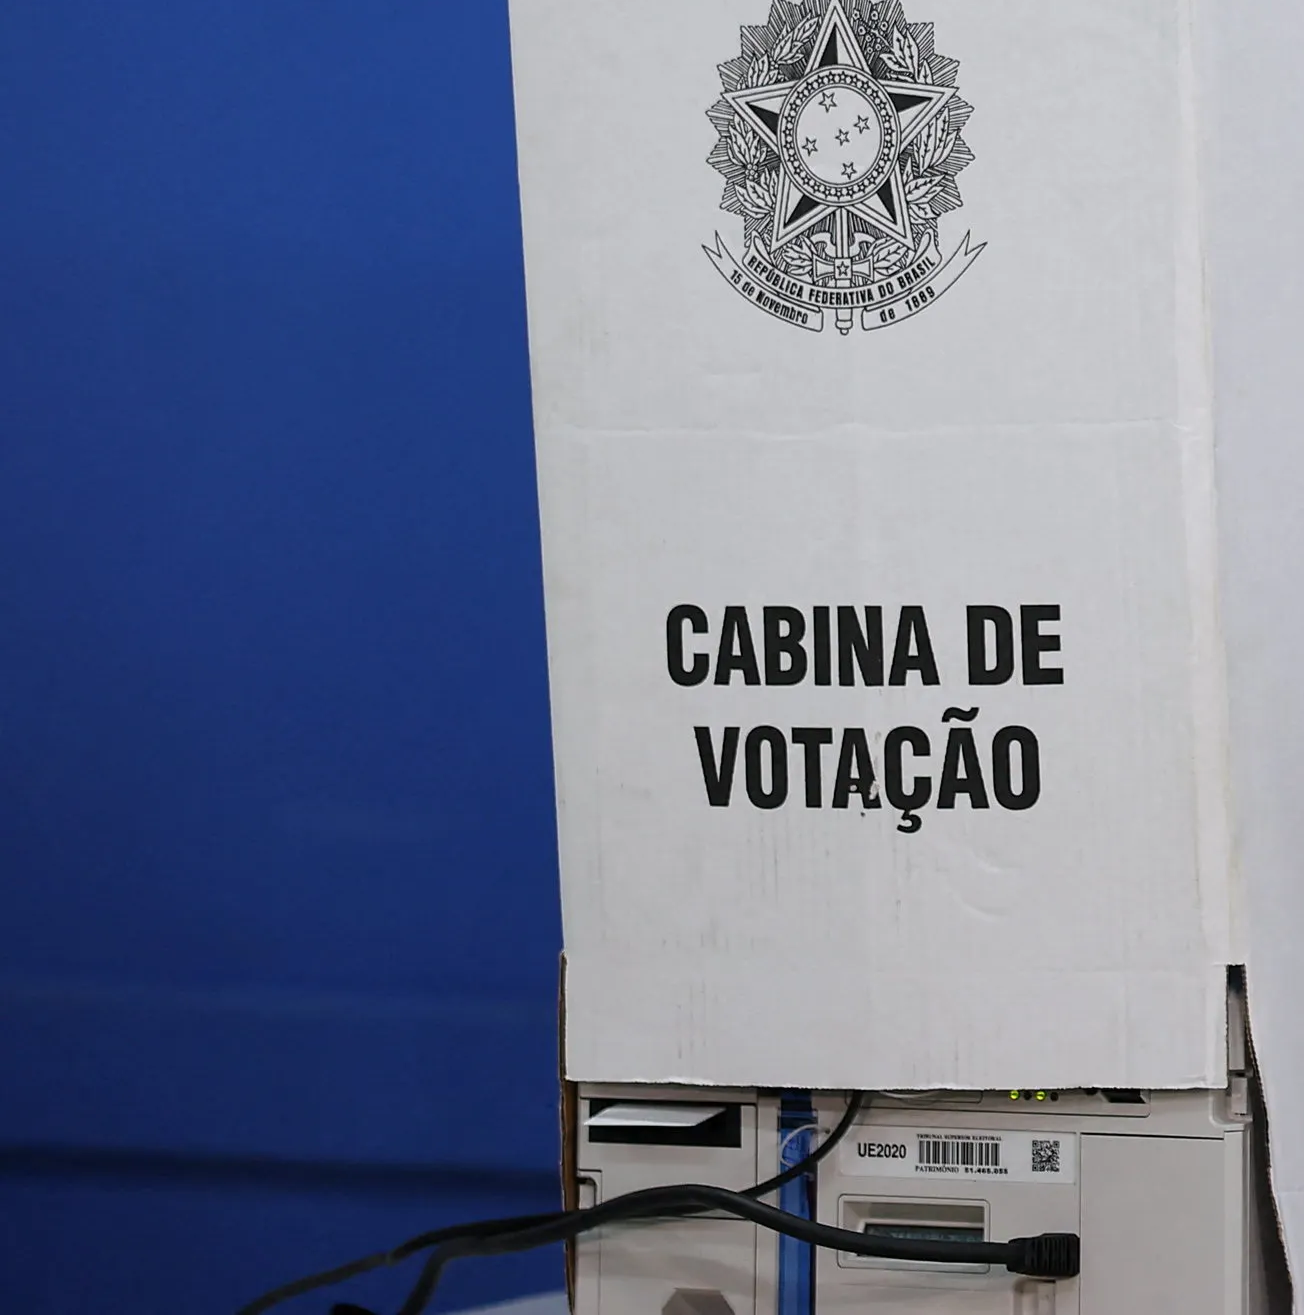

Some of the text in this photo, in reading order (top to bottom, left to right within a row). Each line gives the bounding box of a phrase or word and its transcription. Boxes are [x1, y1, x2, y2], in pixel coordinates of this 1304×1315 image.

[730, 269, 936, 324] 15 de Novembro de 1889
[747, 255, 936, 306] REPÚBLICA FEDERATIVA DO BRASIL
[667, 604, 1064, 686] CABINA DE
[694, 707, 1040, 833] VOTAÇÃO
[857, 1142, 907, 1159] UE2020
[915, 1164, 959, 1173] PATRIMÔNIO
